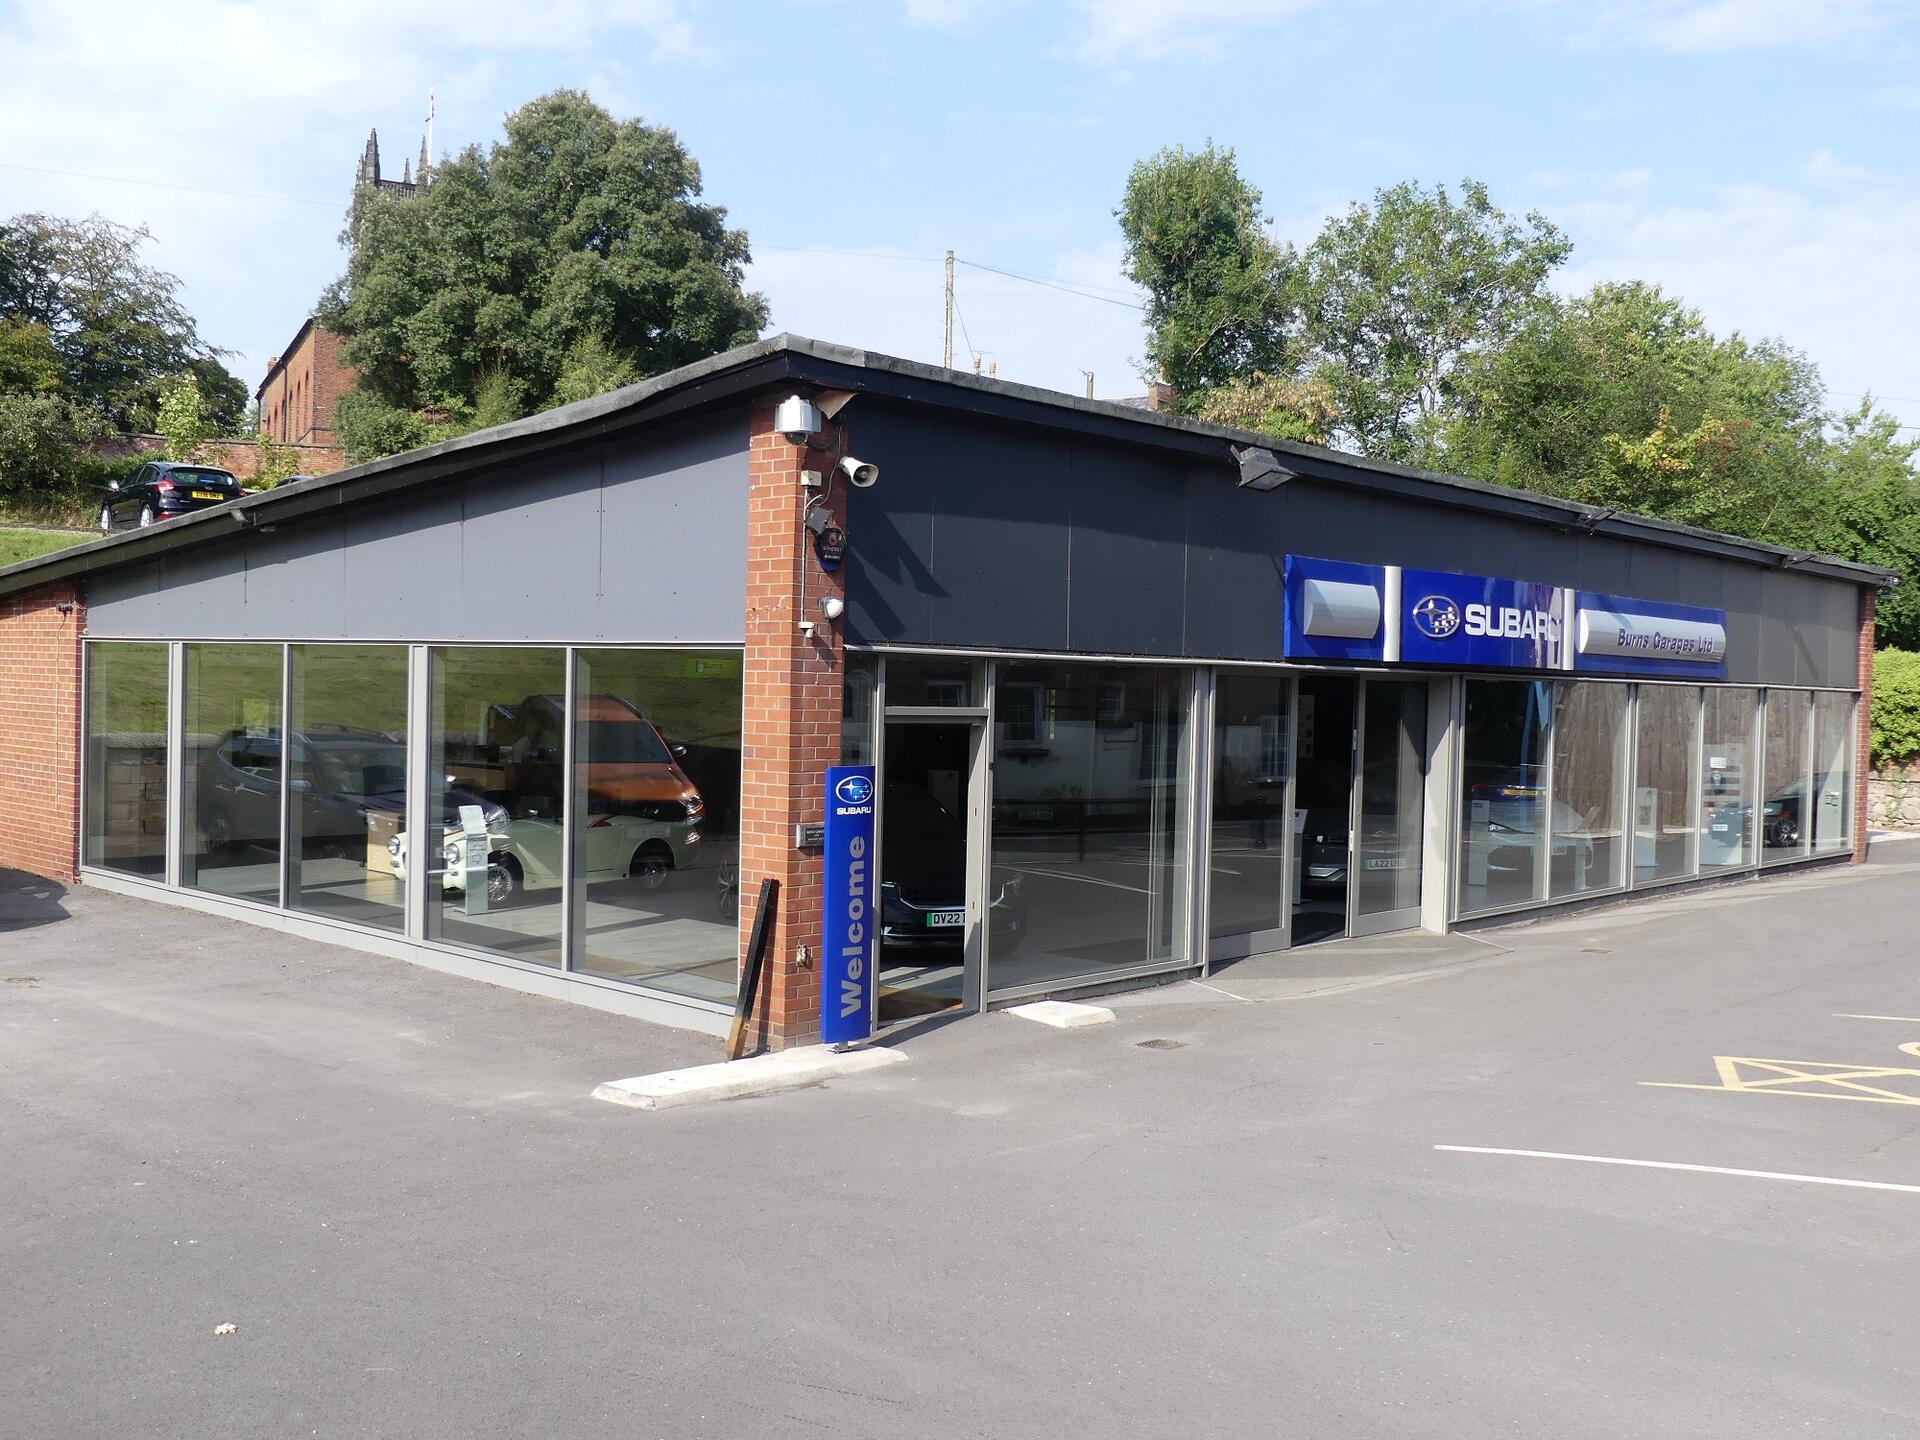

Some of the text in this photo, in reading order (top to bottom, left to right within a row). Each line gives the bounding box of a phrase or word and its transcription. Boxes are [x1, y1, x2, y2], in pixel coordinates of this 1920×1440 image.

[1464, 604, 1561, 641] SUBARU
[1617, 628, 1714, 654] Burns Garages Ltd
[836, 806, 872, 815] SUBARU
[840, 835, 865, 1018] Welcome
